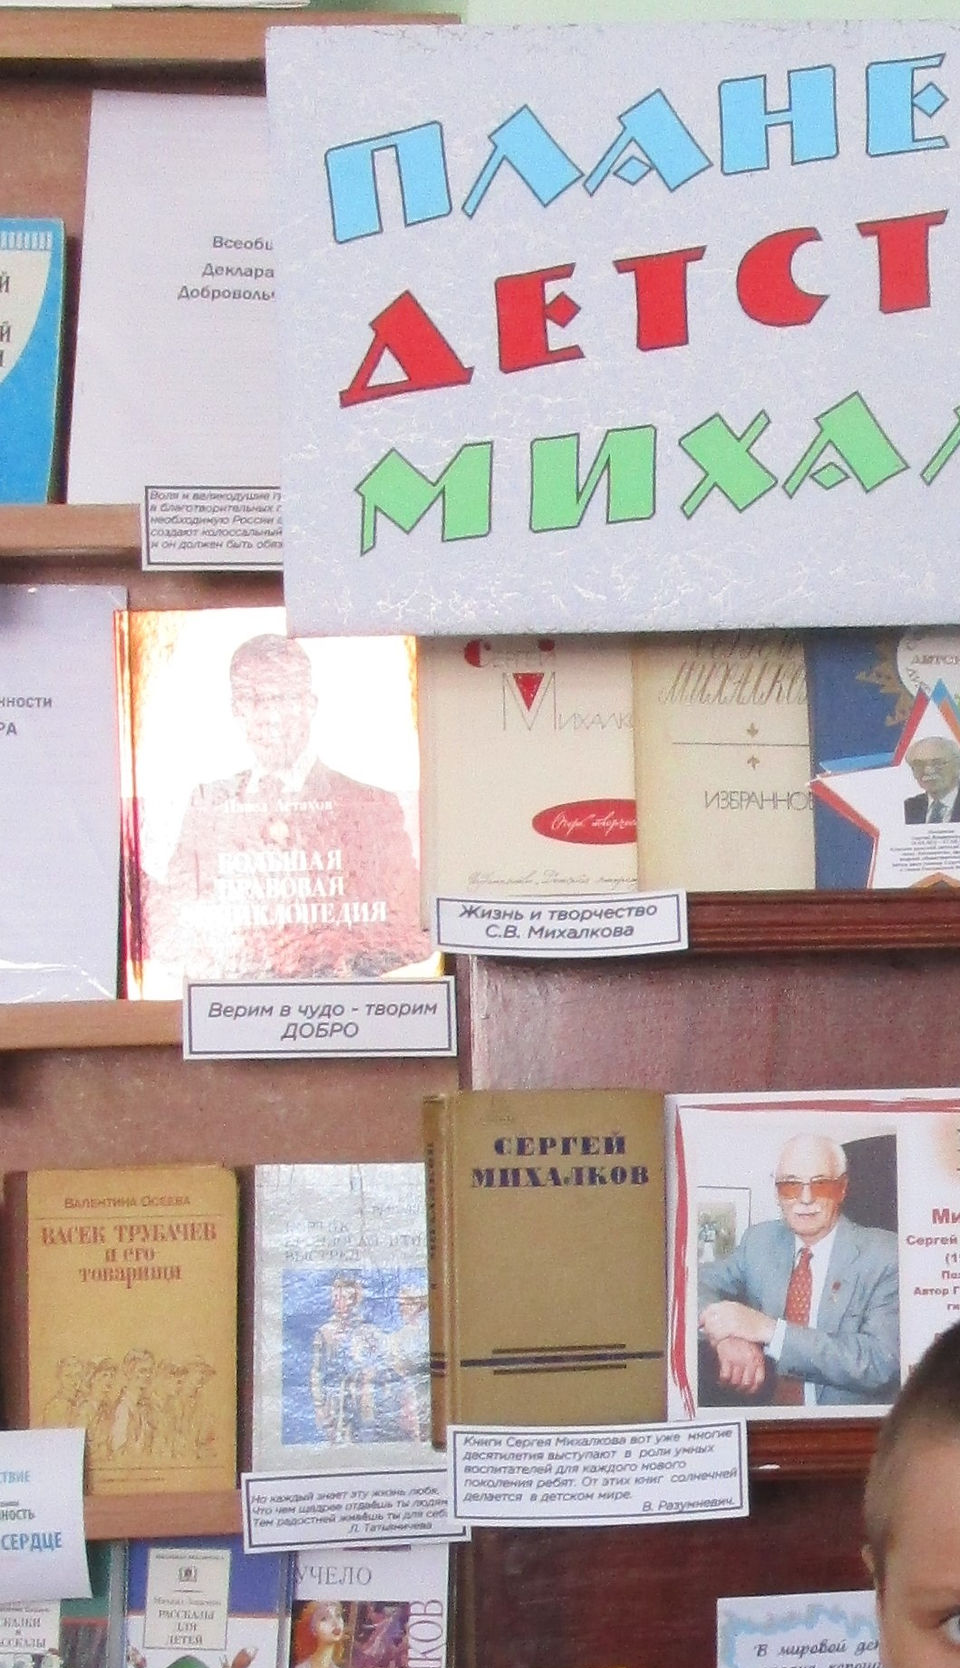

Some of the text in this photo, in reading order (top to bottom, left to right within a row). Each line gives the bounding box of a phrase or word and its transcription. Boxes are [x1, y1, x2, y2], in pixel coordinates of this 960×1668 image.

[458, 903, 658, 922] Жизнь и творчество
[485, 923, 635, 940] С.В. Михалкова
[208, 1002, 437, 1020] Верим в чудо творим
[280, 1022, 359, 1041] ДОБРО
[494, 1130, 627, 1156] СЕРГЕЙ
[471, 1165, 650, 1189] МИХАЛКОВ
[906, 1234, 958, 1247] Сергей
[913, 1286, 949, 1296] Автор
[1, 1531, 62, 1552] СЕРДЦЕ
